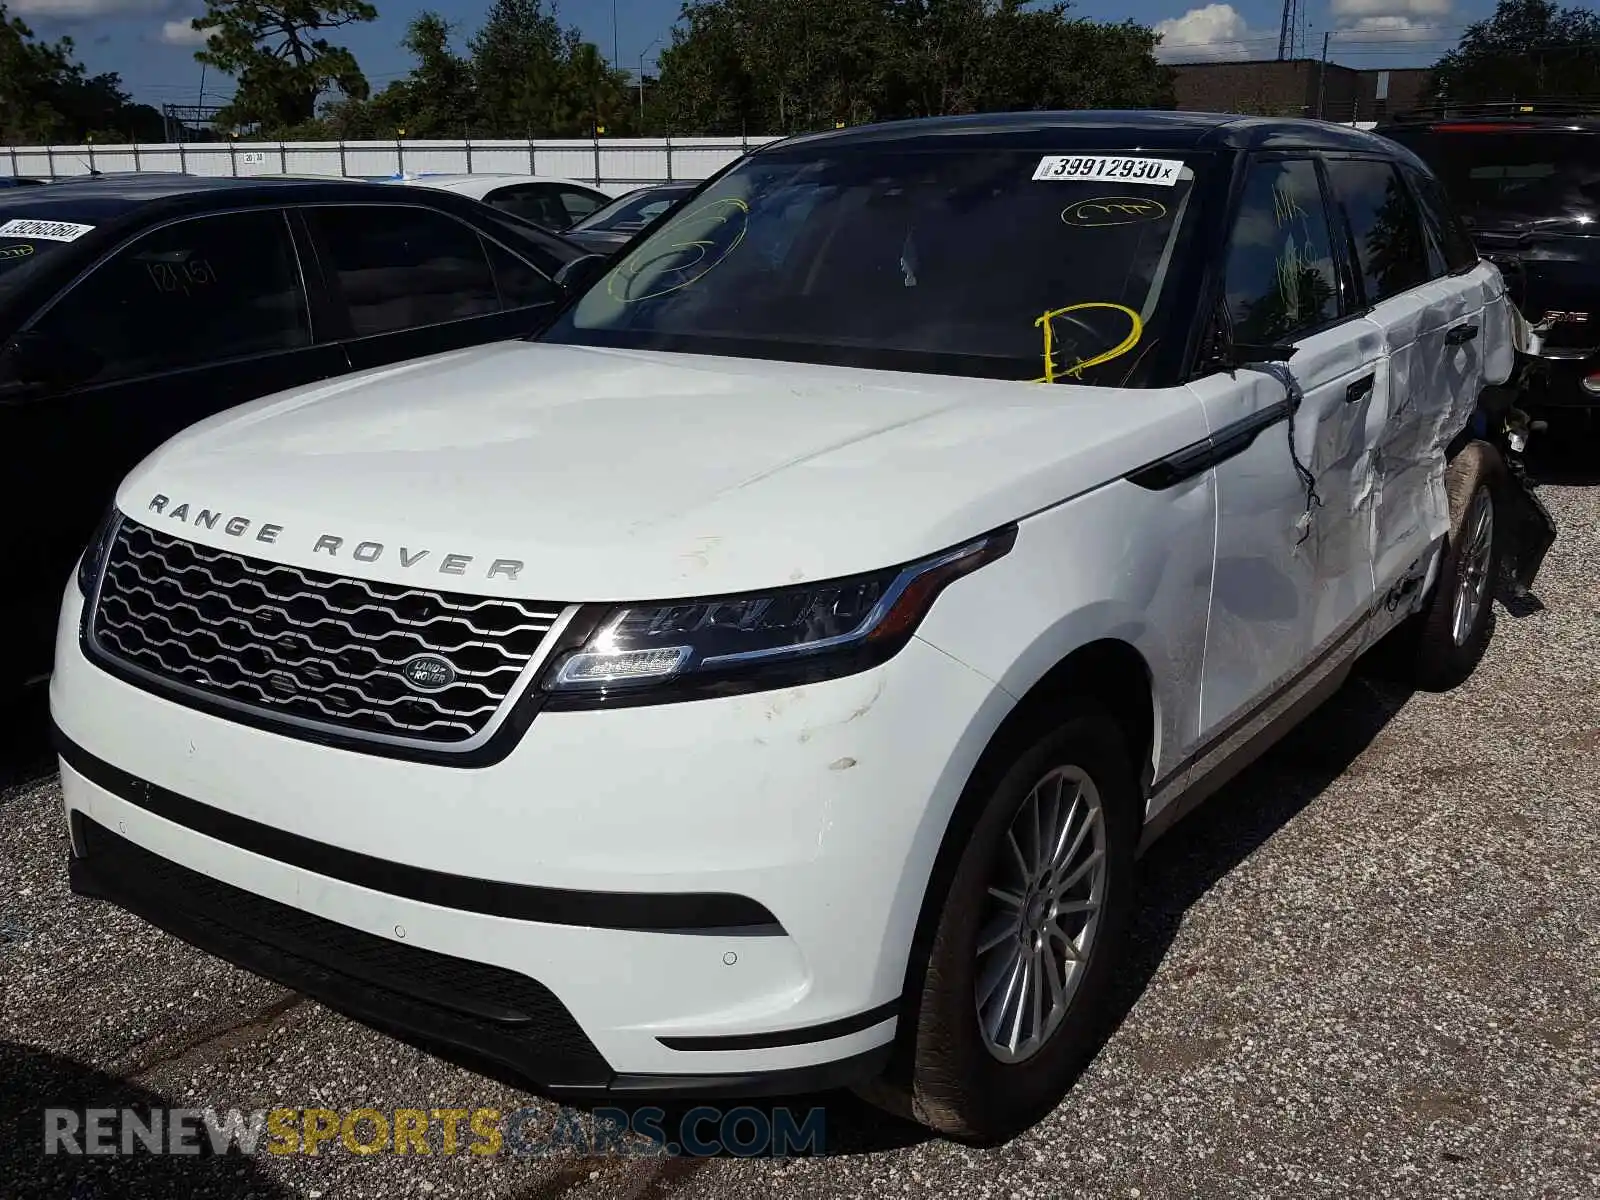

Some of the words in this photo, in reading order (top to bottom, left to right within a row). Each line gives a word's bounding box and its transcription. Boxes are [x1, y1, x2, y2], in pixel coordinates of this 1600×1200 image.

[149, 493, 284, 544] RANGE
[313, 534, 524, 580] ROVER
[414, 661, 441, 673] LAND
[413, 670, 446, 683] ROVER
